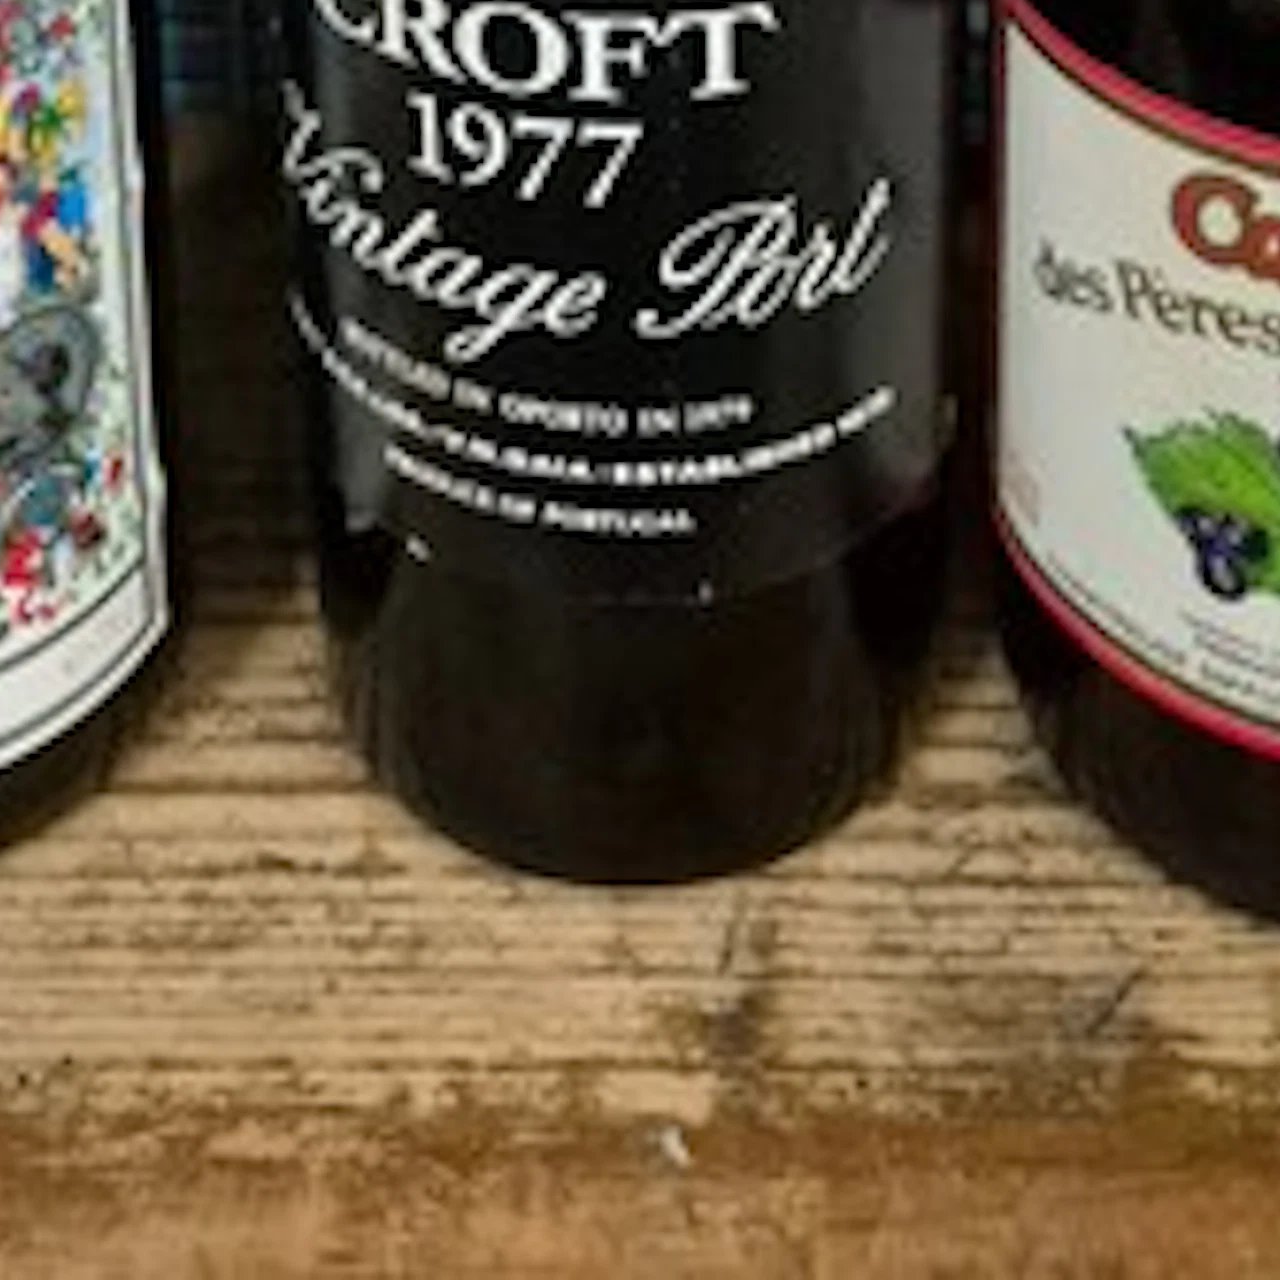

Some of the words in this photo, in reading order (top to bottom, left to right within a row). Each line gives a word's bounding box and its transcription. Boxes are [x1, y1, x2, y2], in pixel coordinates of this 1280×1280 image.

[406, 90, 643, 208] 1977
[282, 78, 608, 362] Vintage
[635, 178, 892, 338] Port
[1032, 240, 1113, 313] des
